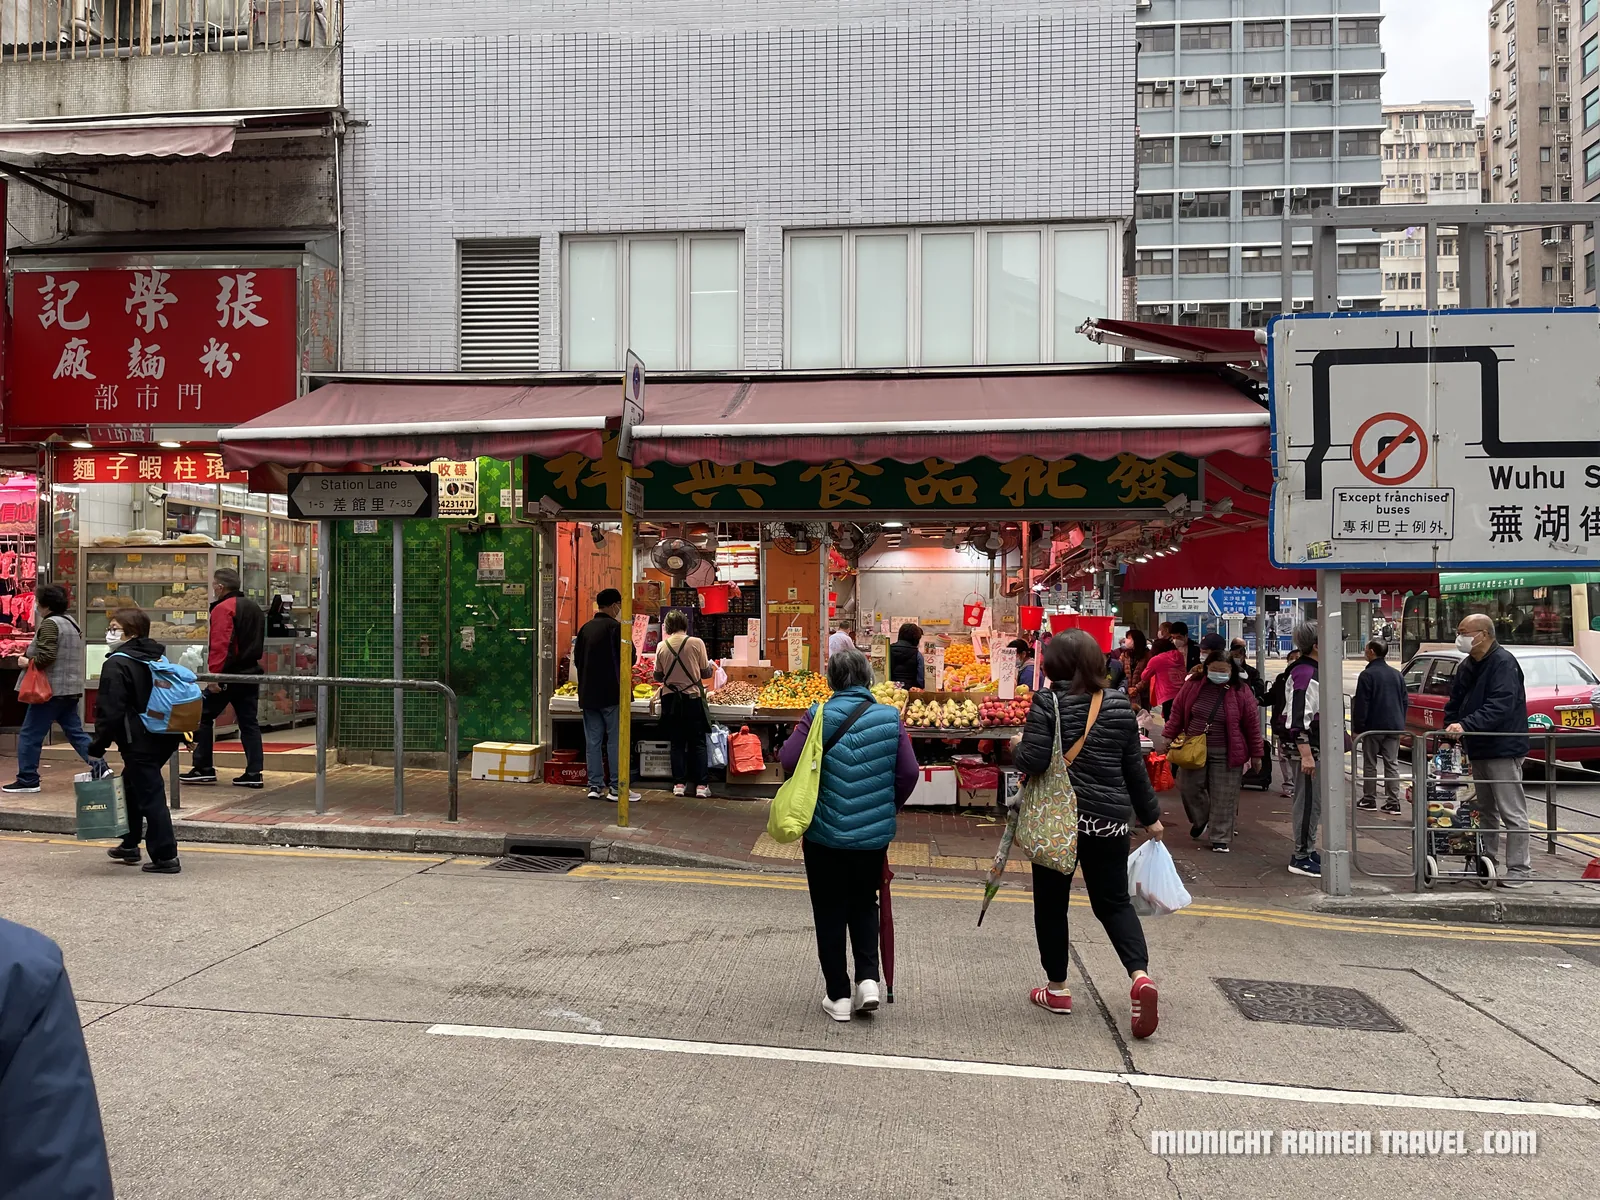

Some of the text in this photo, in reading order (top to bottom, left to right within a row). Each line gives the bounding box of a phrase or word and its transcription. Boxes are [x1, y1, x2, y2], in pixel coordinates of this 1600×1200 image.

[37, 271, 269, 333] 張榮記
[52, 337, 241, 380] 粉麵廠
[94, 383, 203, 411] 門市部
[72, 456, 248, 481] 瑤柱蝦子麵
[437, 463, 468, 477] 收碟
[1489, 465, 1565, 490] Wuhu
[320, 479, 398, 491] Station Lane
[308, 497, 413, 512] 1-5 差館里 7-35
[1340, 491, 1448, 504] Except franchised
[1375, 504, 1410, 515] buses
[1342, 520, 1444, 534] 專利巴士例外
[1570, 710, 1584, 719] CW
[1565, 717, 1592, 727] 3709
[561, 769, 579, 780] envy
